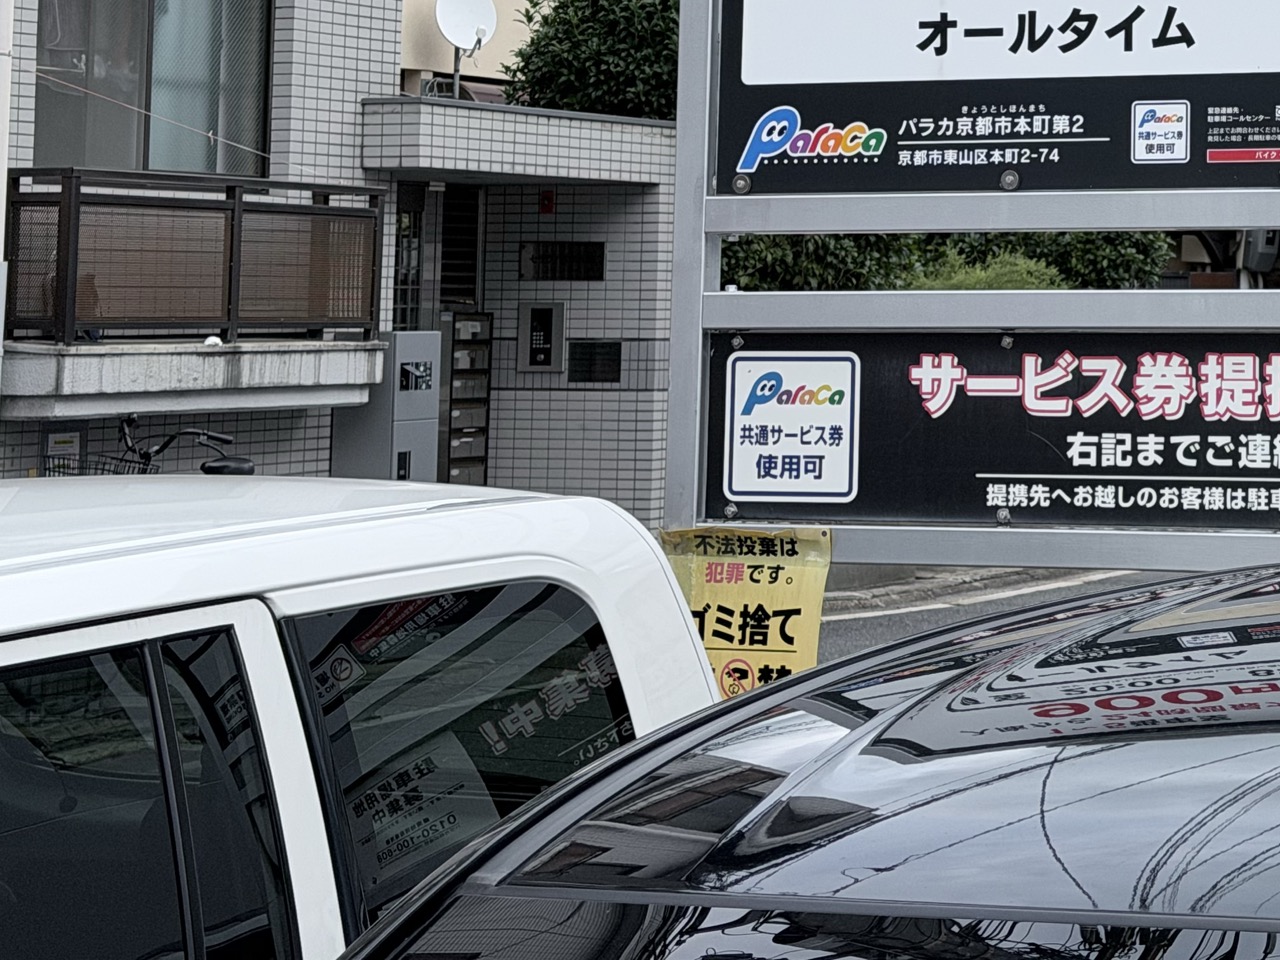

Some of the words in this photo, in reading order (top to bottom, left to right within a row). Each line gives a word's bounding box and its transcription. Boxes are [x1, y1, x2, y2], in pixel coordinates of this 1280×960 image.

[916, 5, 1196, 56] オールタイム
[898, 115, 1085, 137] パラカ京都市本町第2
[1138, 131, 1183, 141] 共通サービス券
[897, 148, 1060, 167] 京都市東山区本町2-74
[1144, 143, 1176, 155] 使用可
[740, 424, 844, 448] 共通サービス券
[756, 453, 825, 481] 使用可
[694, 534, 799, 557] 不法投棄は
[706, 562, 793, 585] 犯罪です。
